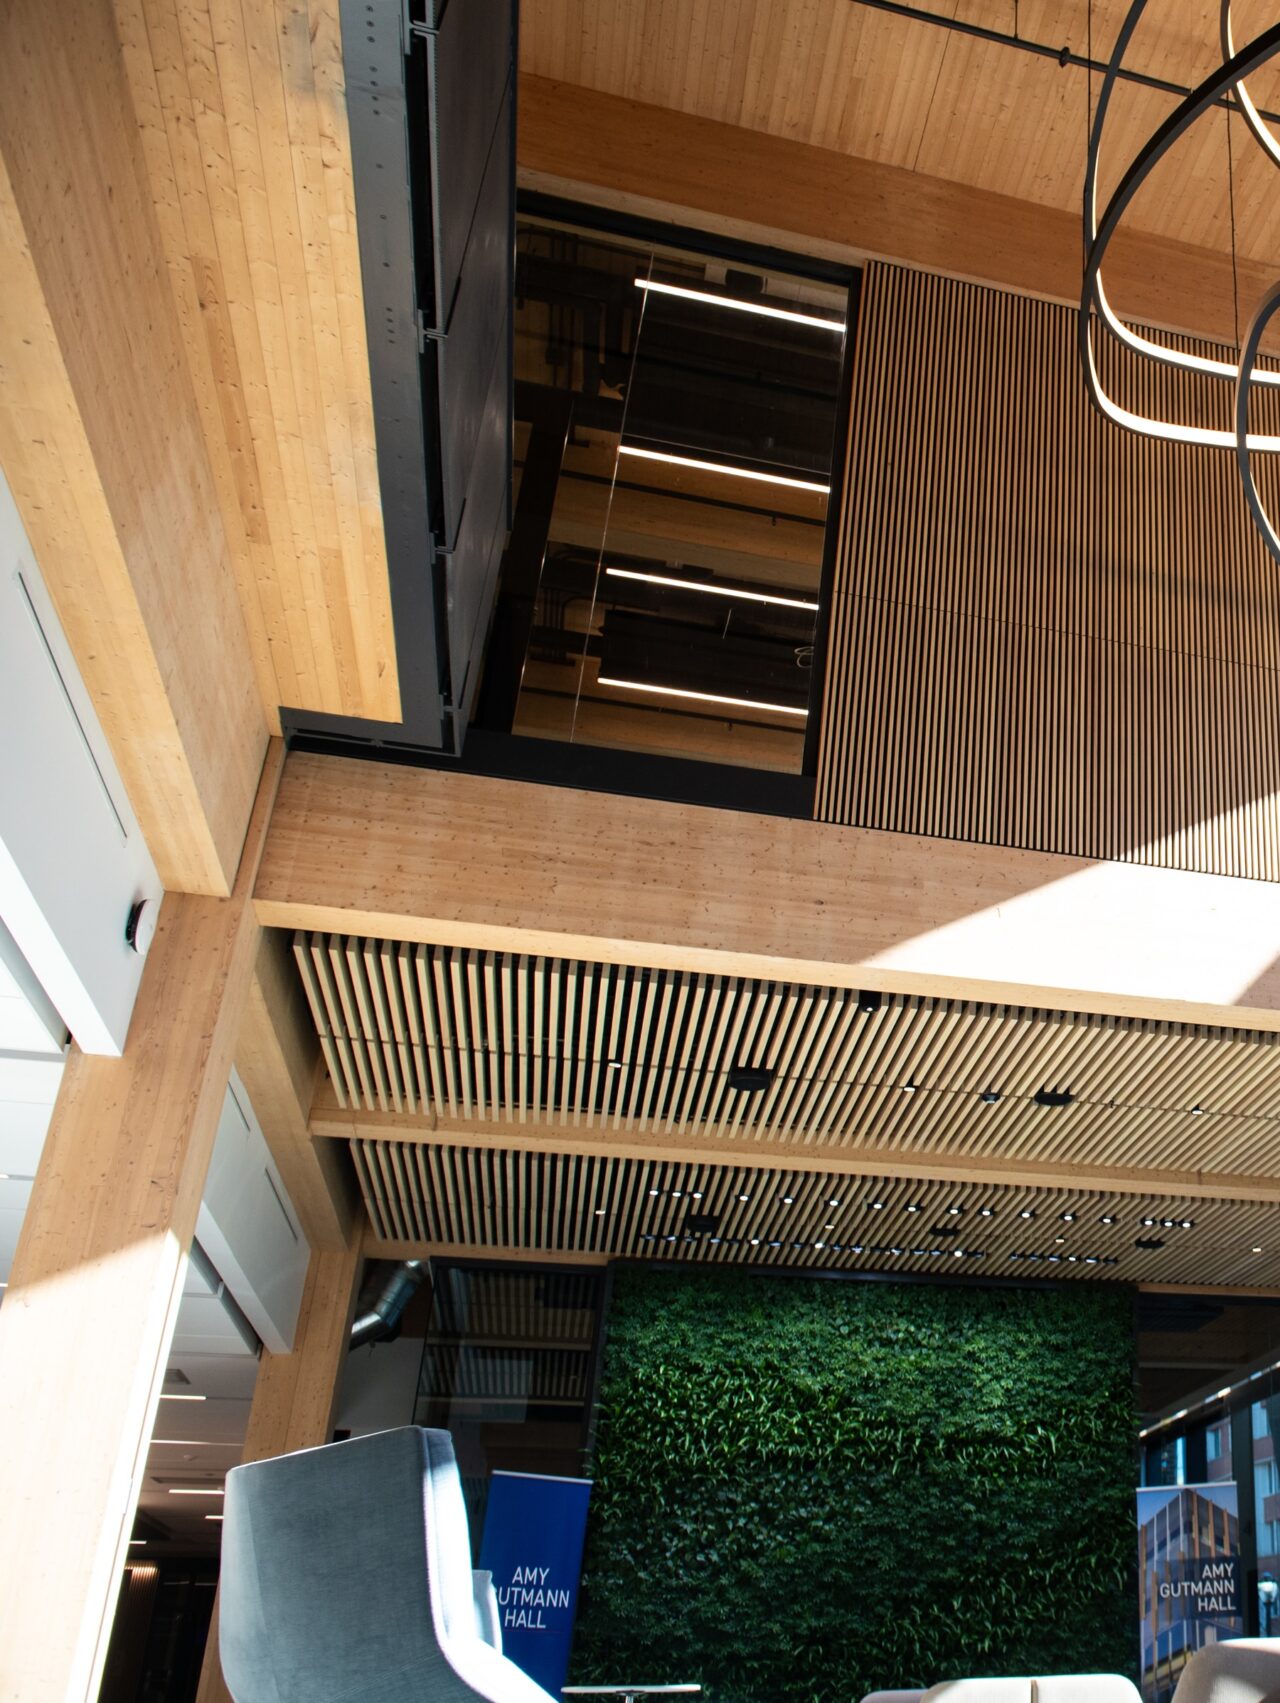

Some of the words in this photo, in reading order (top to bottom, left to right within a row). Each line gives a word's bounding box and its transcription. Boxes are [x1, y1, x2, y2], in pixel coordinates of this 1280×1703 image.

[512, 1566, 550, 1586] AMY
[1202, 1562, 1234, 1579] AMY
[495, 1586, 570, 1608] UTMANN
[1159, 1578, 1235, 1598] GUTMANN
[1197, 1595, 1237, 1612] HALL
[504, 1608, 546, 1629] HALL
